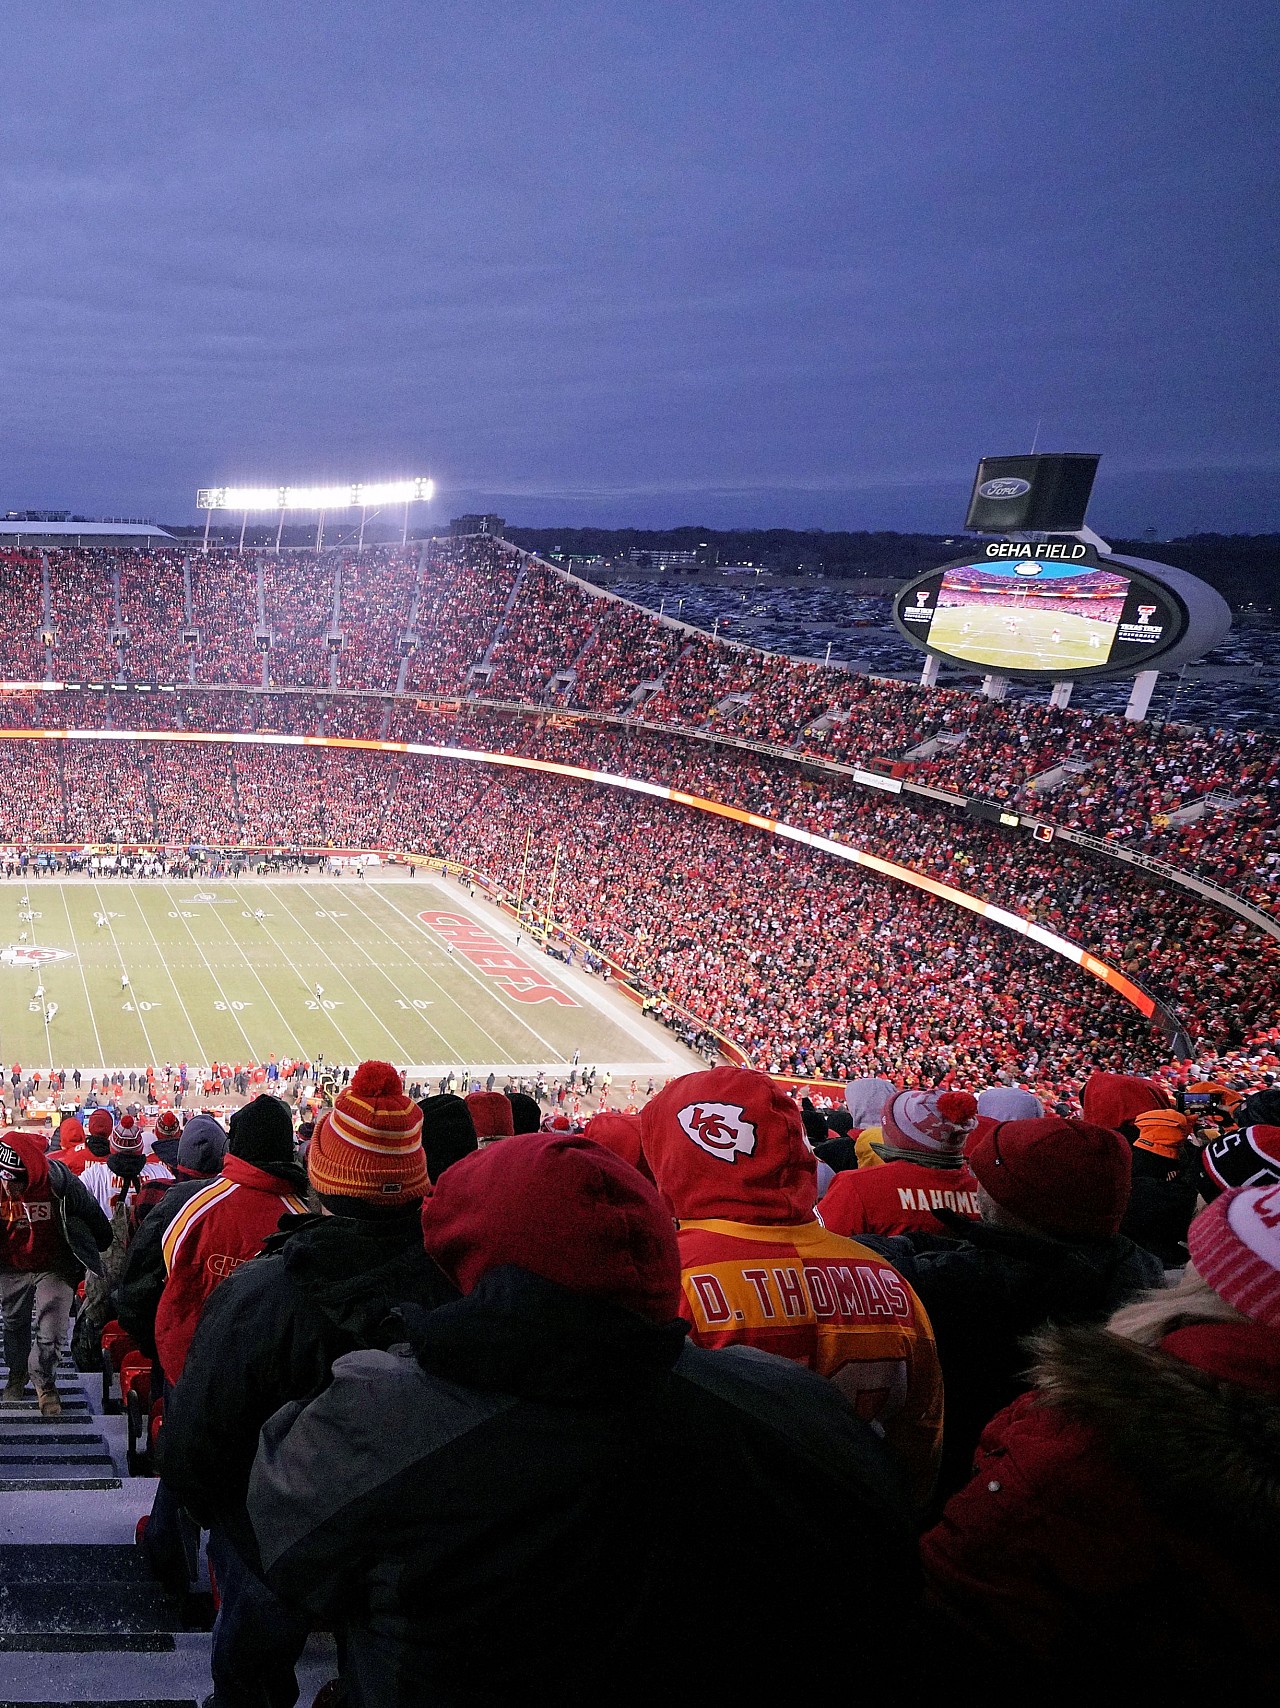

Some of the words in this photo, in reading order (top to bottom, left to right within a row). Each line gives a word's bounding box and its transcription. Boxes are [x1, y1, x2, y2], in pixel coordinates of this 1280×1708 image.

[986, 481, 1020, 496] Ford
[986, 543, 1033, 557] GEHA
[1035, 544, 1086, 559] FIELD
[718, 737, 737, 746] CARSON
[756, 745, 784, 757] GONZALEZ
[1148, 861, 1173, 878] ANDERS
[416, 910, 584, 1007] CHIEFS
[28, 1001, 59, 1012] 50
[121, 1001, 152, 1012] 40
[213, 1000, 245, 1011] 30
[305, 999, 336, 1010] 20
[394, 999, 423, 1010] 10
[689, 1273, 745, 1324] D.
[742, 1266, 911, 1318] THOMAS
